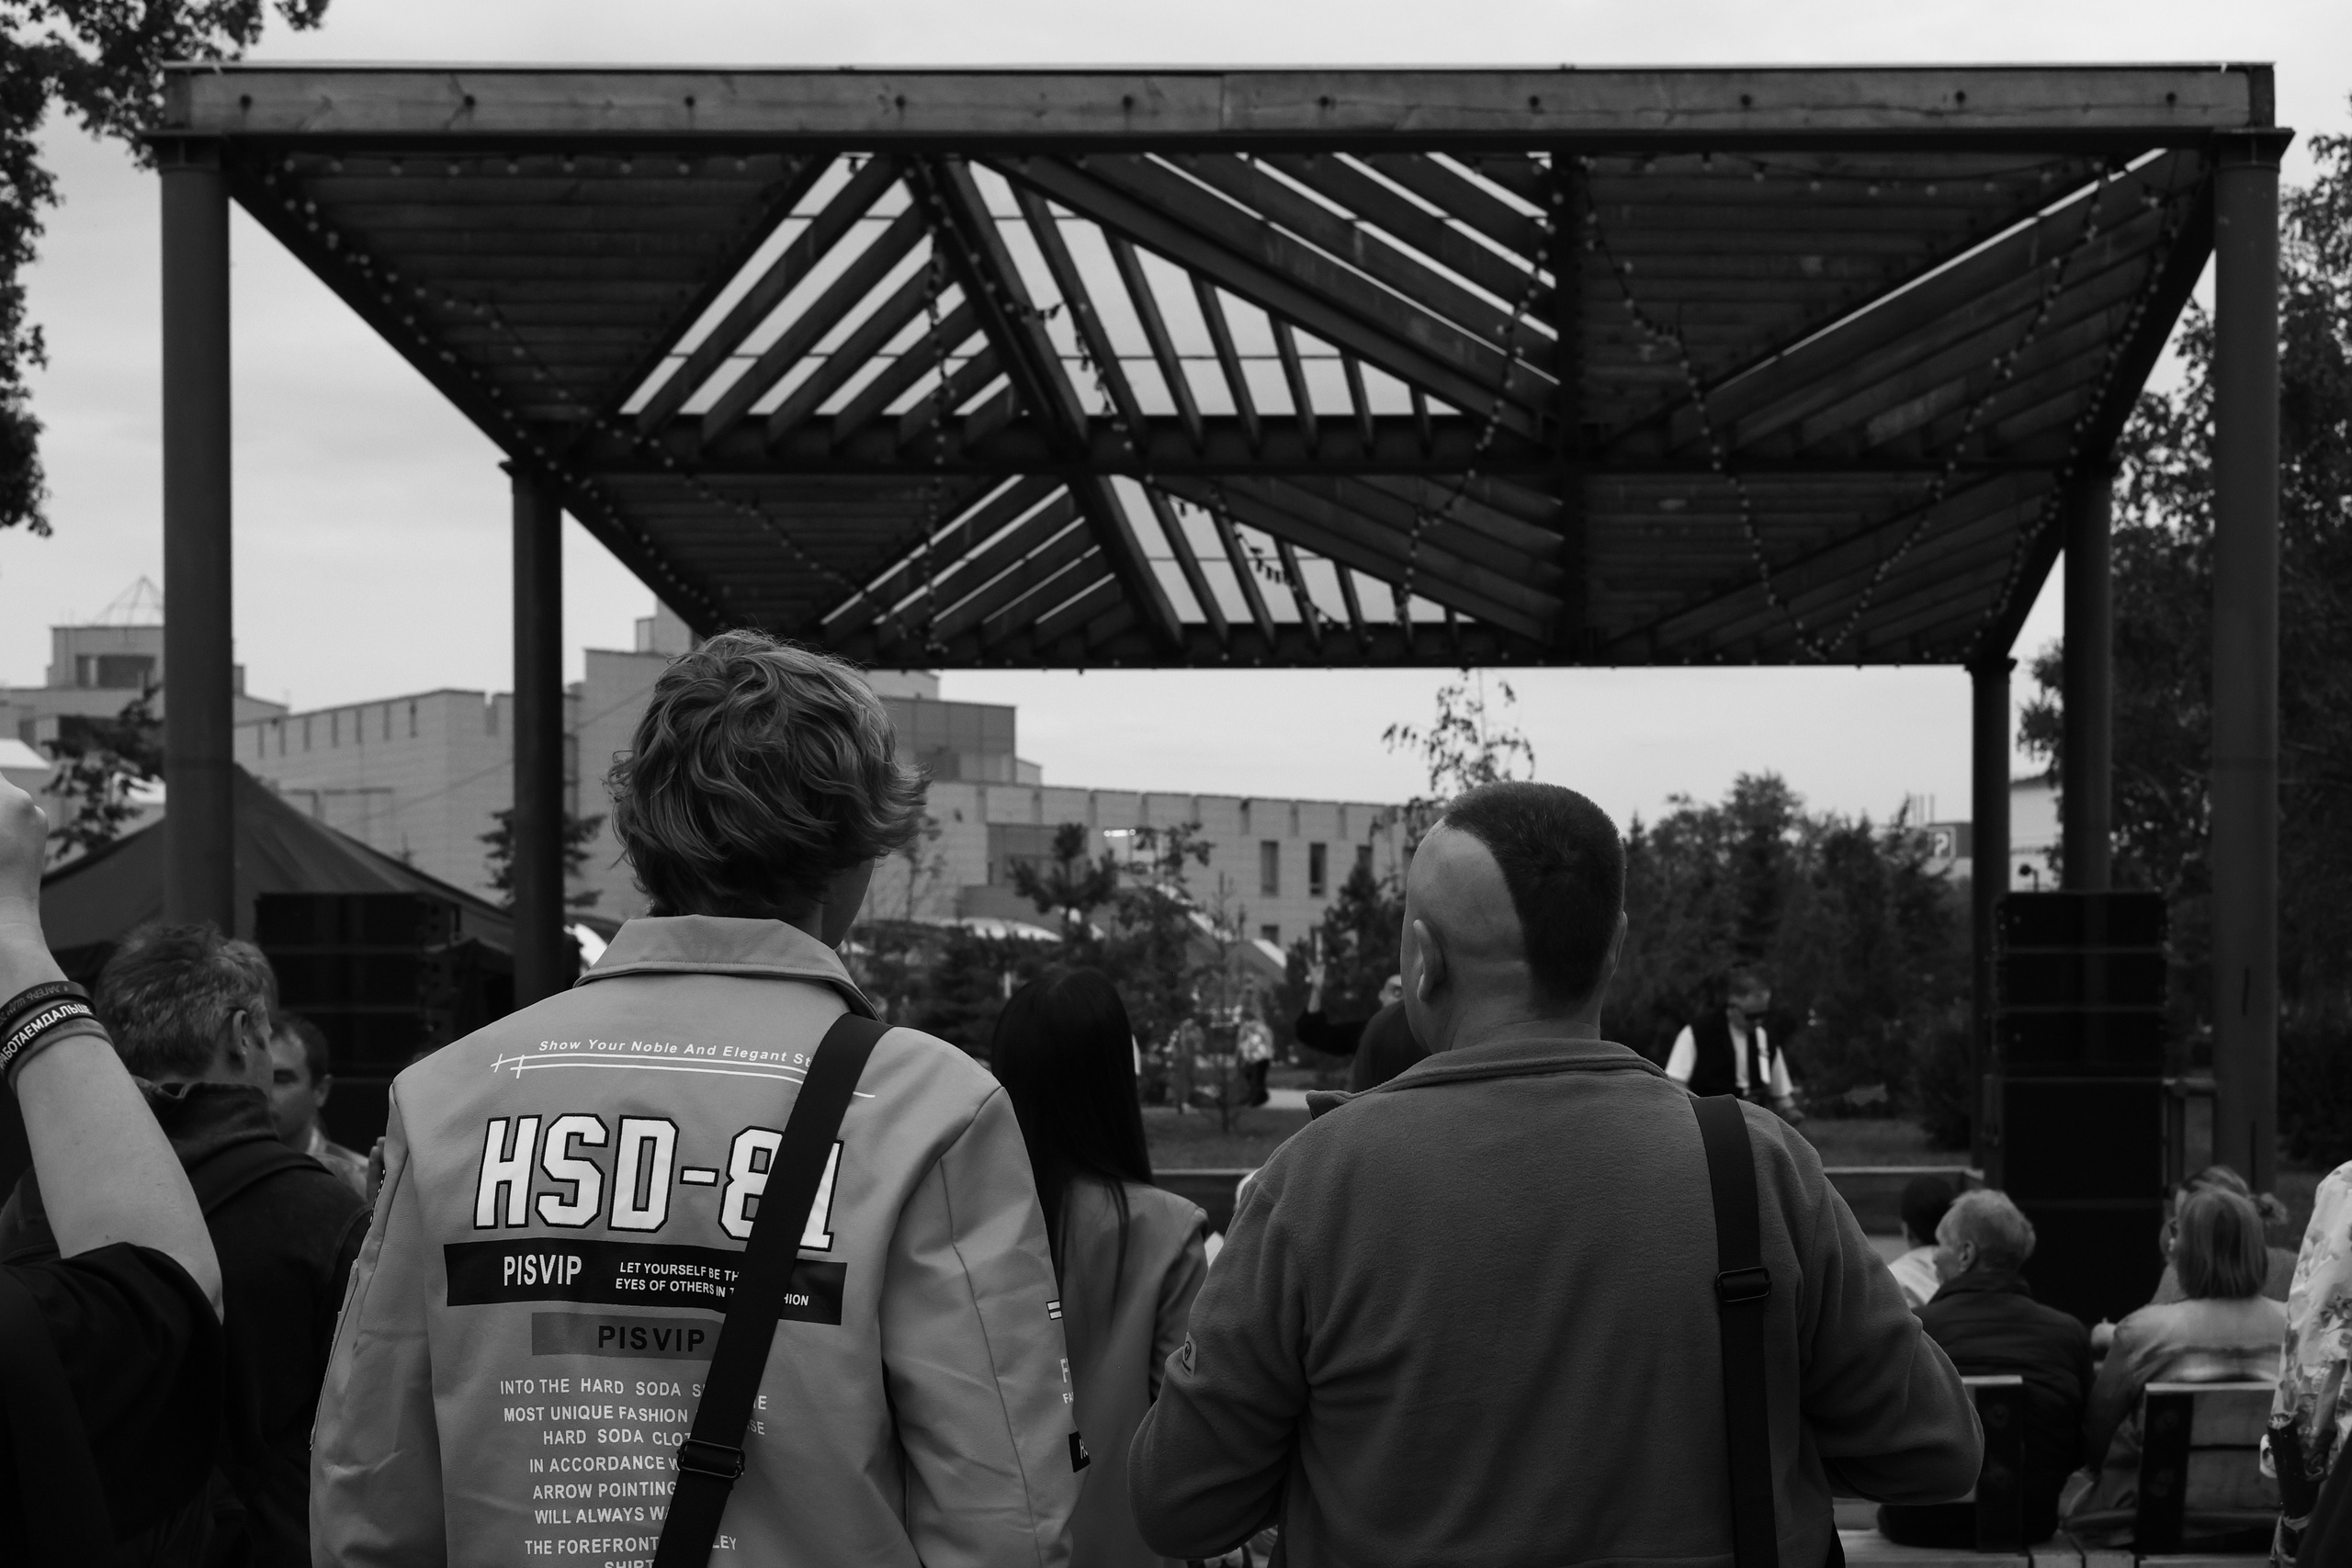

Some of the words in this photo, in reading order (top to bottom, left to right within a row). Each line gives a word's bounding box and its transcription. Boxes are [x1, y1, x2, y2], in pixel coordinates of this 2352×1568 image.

[538, 1040, 582, 1052] Show
[588, 1039, 627, 1051] Your
[630, 1041, 678, 1054] Noble
[683, 1043, 717, 1055] And
[722, 1045, 787, 1062] Elegant
[792, 1053, 811, 1068] St
[503, 1254, 582, 1287] PISVIP
[619, 1261, 641, 1274] LET
[643, 1262, 707, 1277] YOURSELF
[708, 1267, 721, 1280] BE
[724, 1269, 740, 1282] TH
[615, 1278, 646, 1291] EYES
[649, 1279, 667, 1292] OF
[669, 1280, 715, 1295] OTHERS
[716, 1285, 726, 1298] IN
[784, 1292, 809, 1306] HION
[597, 1325, 706, 1352] PISVIP
[500, 1379, 535, 1395] INTO
[538, 1378, 570, 1394] THE
[581, 1378, 624, 1394] HARD
[635, 1381, 682, 1397] SODA
[503, 1406, 545, 1422] MOST
[550, 1404, 614, 1421] UNIQUE
[618, 1405, 688, 1423] FASHION
[543, 1429, 587, 1446] HARD
[597, 1427, 644, 1445] SODA
[529, 1458, 544, 1473] IN
[548, 1455, 666, 1473] ACCORDANCE
[532, 1483, 593, 1500] ARROW
[598, 1481, 676, 1498] POINTING
[534, 1508, 571, 1525] WILL
[575, 1506, 645, 1524] ALWAYS
[524, 1540, 553, 1555] THE
[558, 1536, 660, 1555] FOREFRONT
